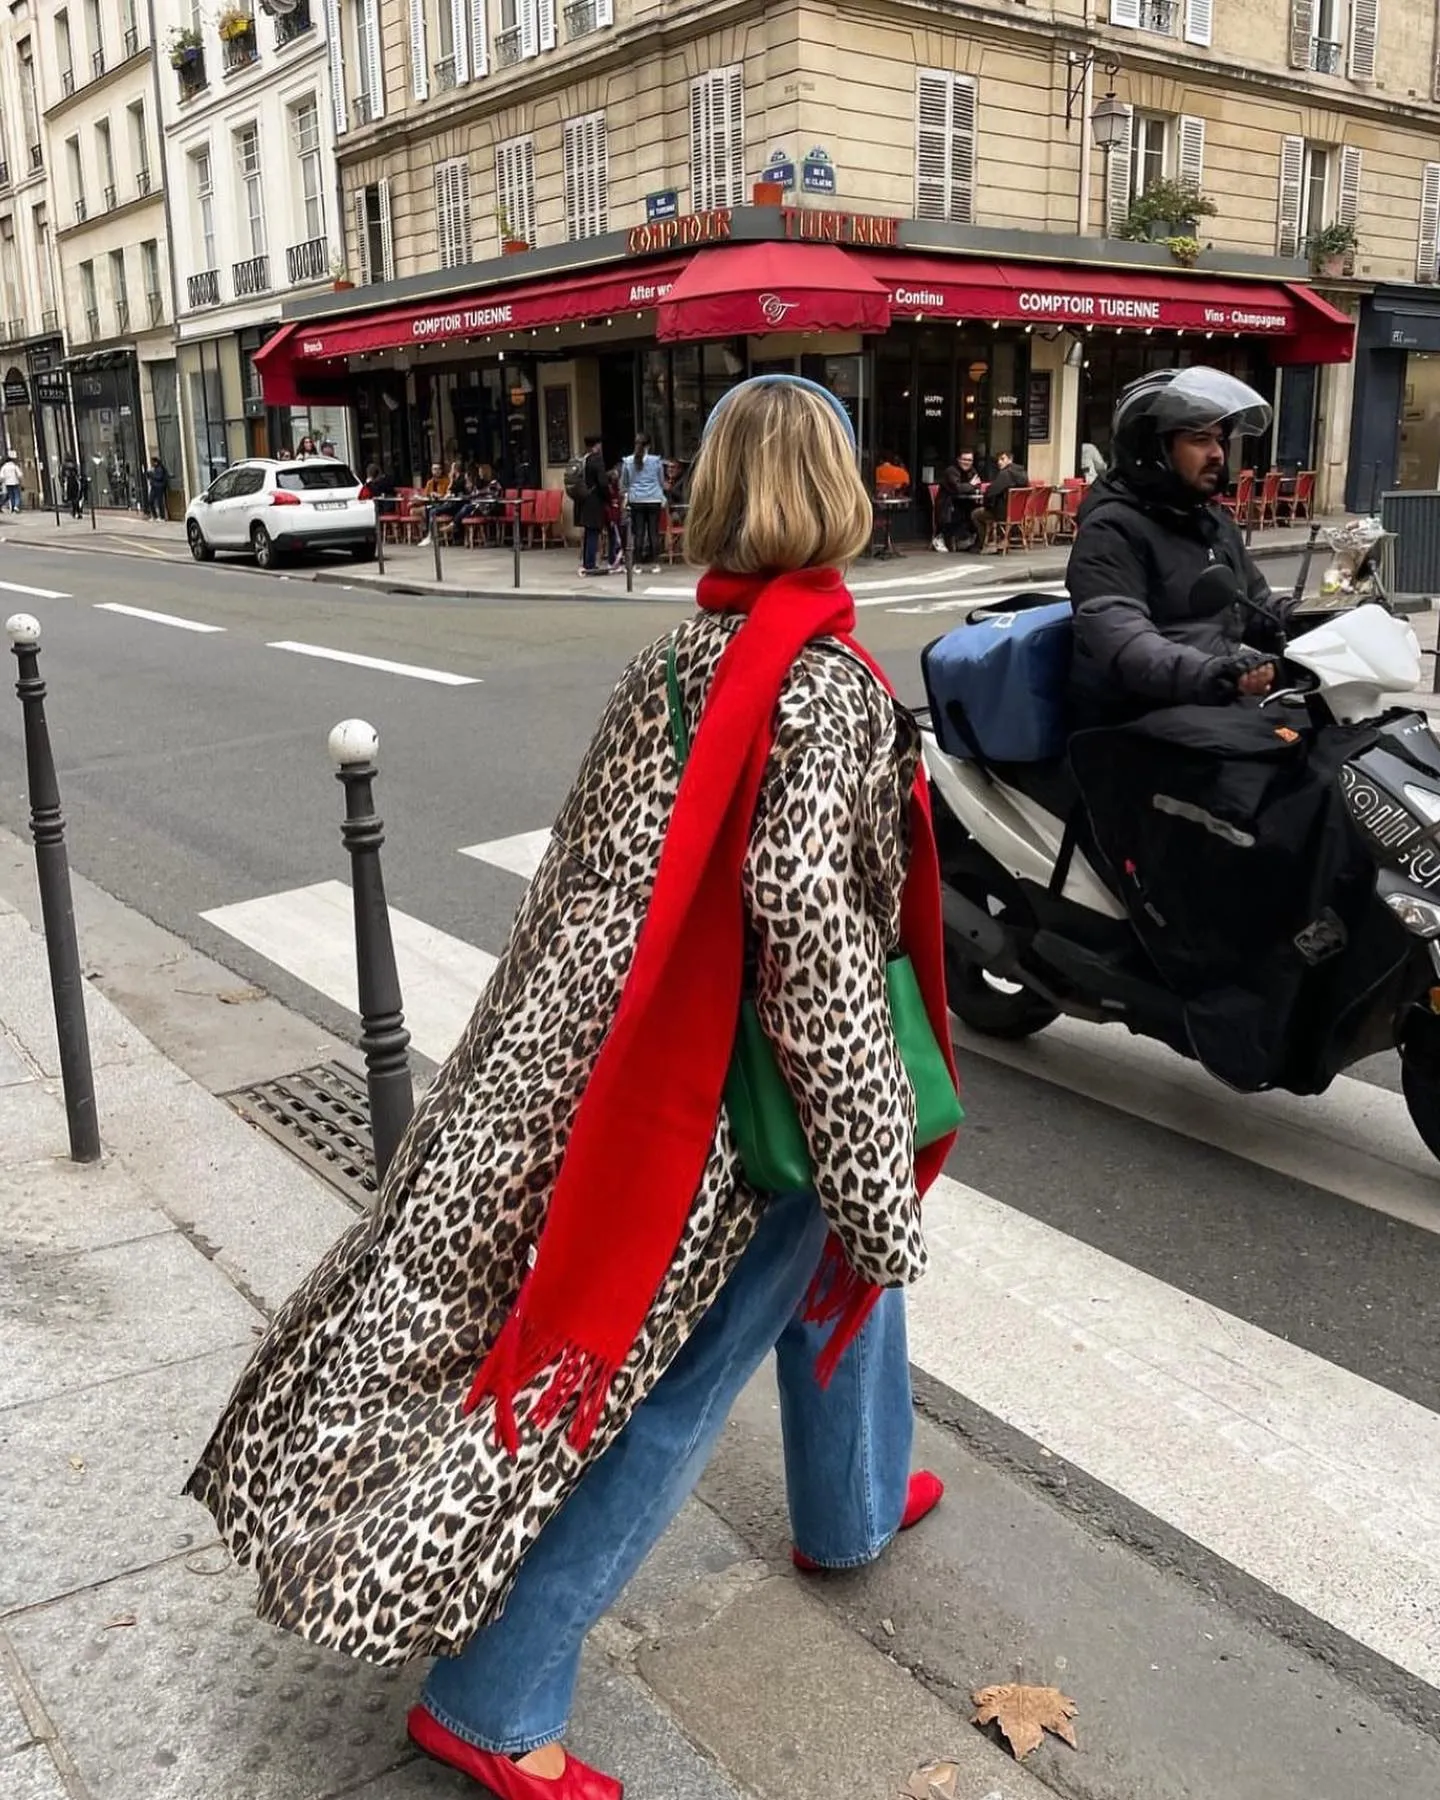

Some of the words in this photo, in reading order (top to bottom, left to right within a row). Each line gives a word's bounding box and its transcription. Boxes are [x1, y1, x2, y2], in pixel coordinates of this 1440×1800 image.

[656, 204, 675, 216] TURENNE
[629, 210, 732, 254] COMPTOIR
[780, 207, 903, 246] TURENNE
[630, 285, 656, 301] After
[895, 288, 944, 306] Continu
[1018, 293, 1094, 314] COMPTOIR
[1098, 299, 1160, 318] TURENNE
[412, 314, 461, 335] COMPTOIR
[464, 305, 513, 328] TURENNE
[1204, 308, 1224, 323] Vins
[1231, 310, 1286, 328] Champagnes
[924, 394, 944, 404] HAPPY
[925, 409, 942, 417] HOUR
